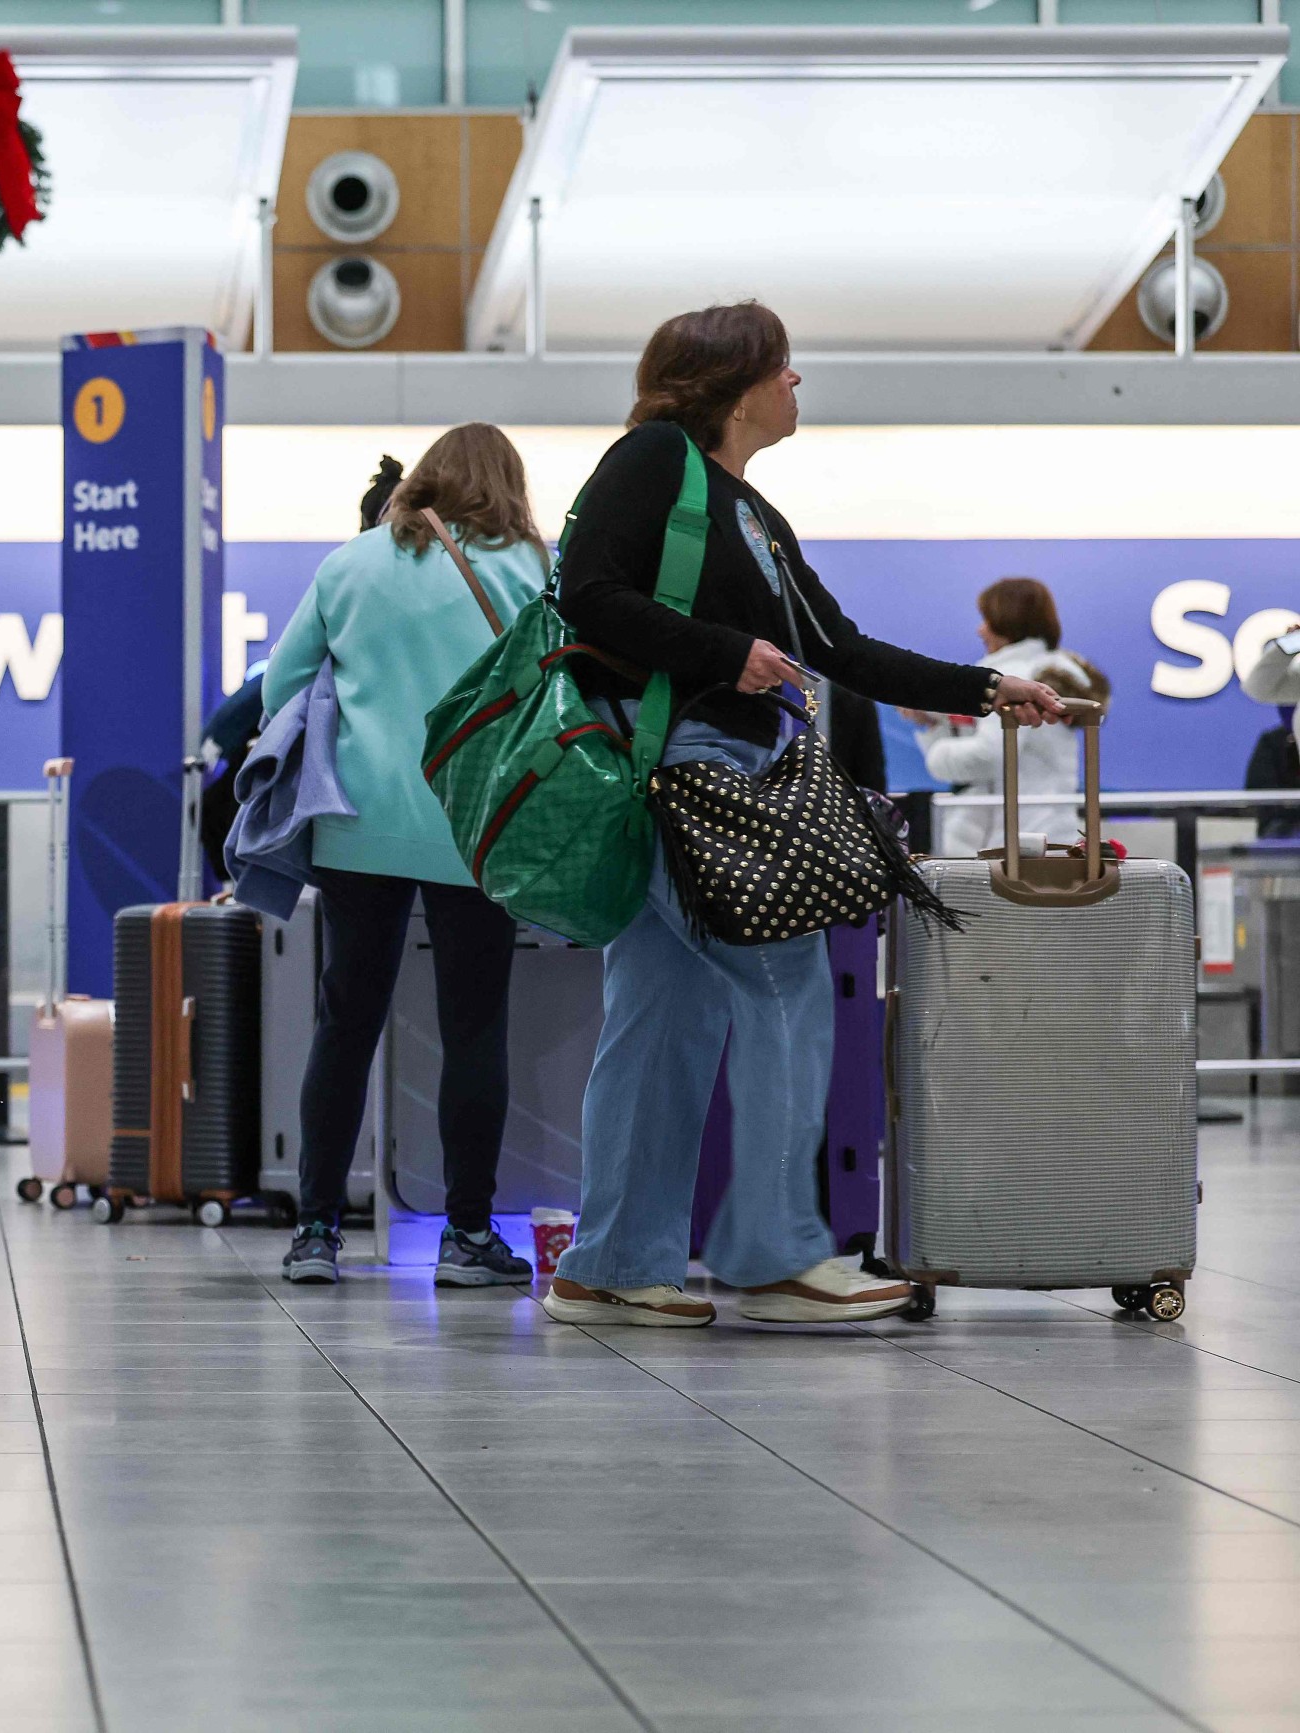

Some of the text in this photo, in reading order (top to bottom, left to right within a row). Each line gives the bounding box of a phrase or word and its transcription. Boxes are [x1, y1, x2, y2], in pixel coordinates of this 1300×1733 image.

[92, 395, 104, 426] 1
[73, 480, 138, 512] Start
[73, 521, 139, 551] Here
